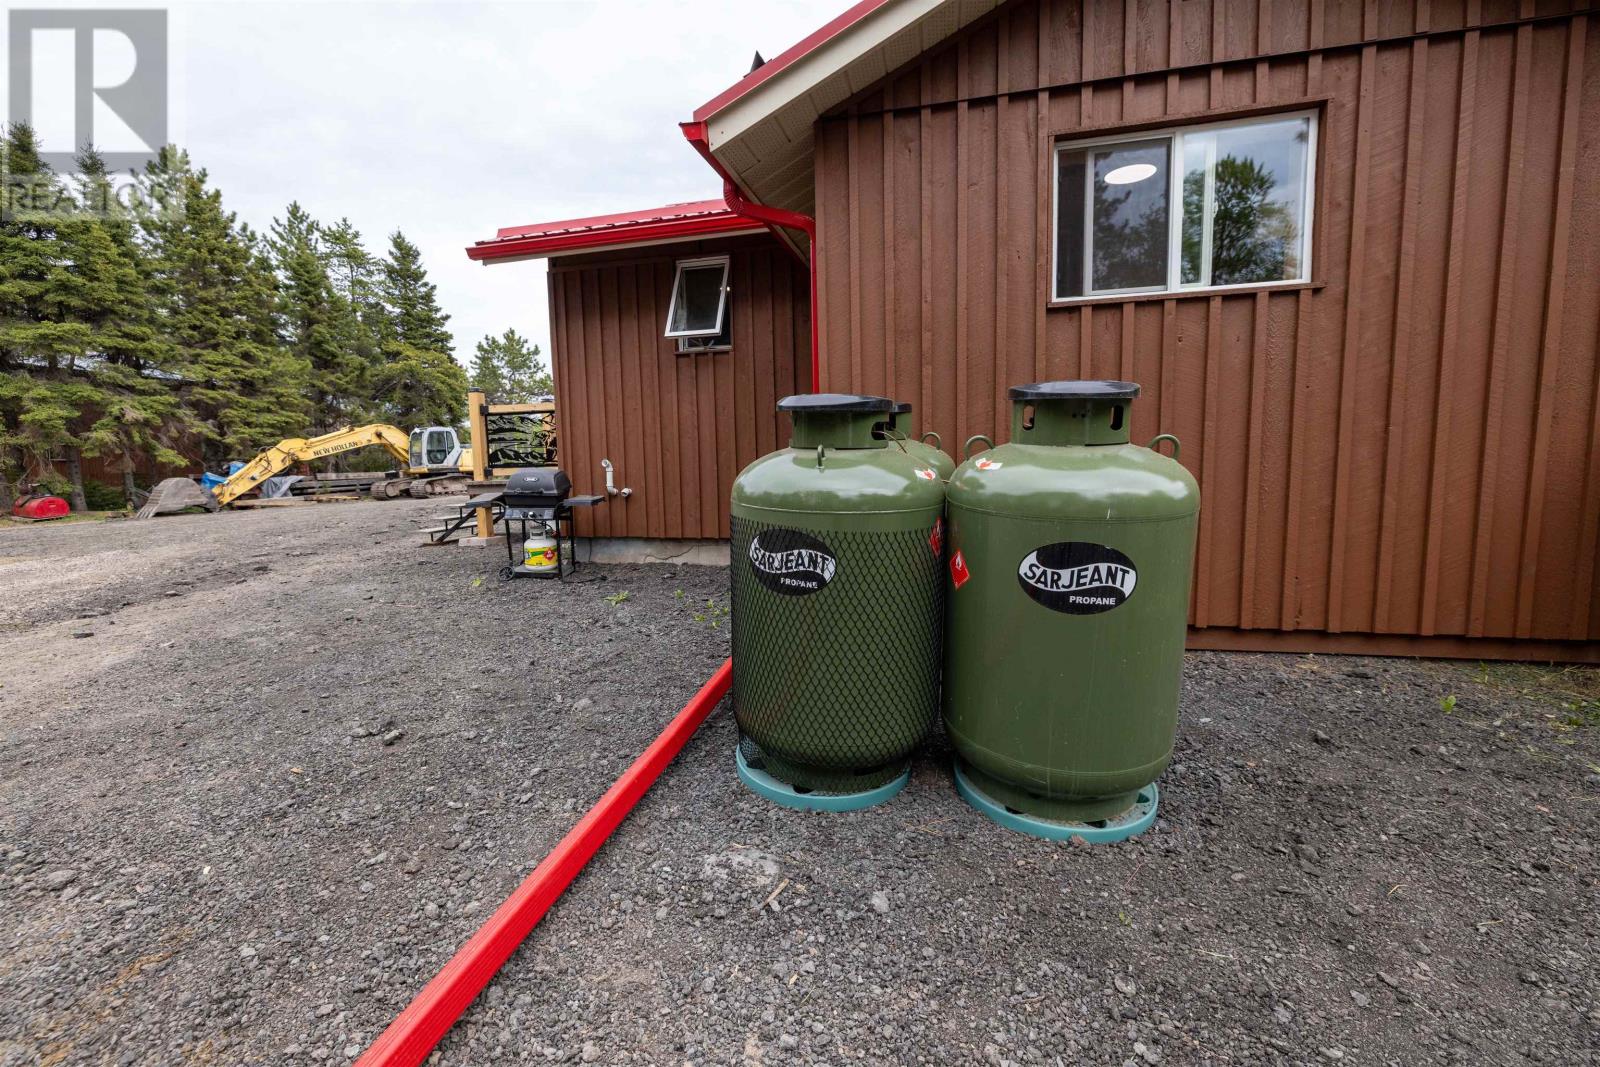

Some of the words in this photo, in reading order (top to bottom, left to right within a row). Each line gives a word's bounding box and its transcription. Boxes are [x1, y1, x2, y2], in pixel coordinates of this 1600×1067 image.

[313, 447, 330, 456] NEW
[752, 546, 831, 575] SARJEANT
[1024, 564, 1130, 589] SARJEANT
[780, 577, 818, 588] PROPANE
[1069, 596, 1116, 605] PROPANE
